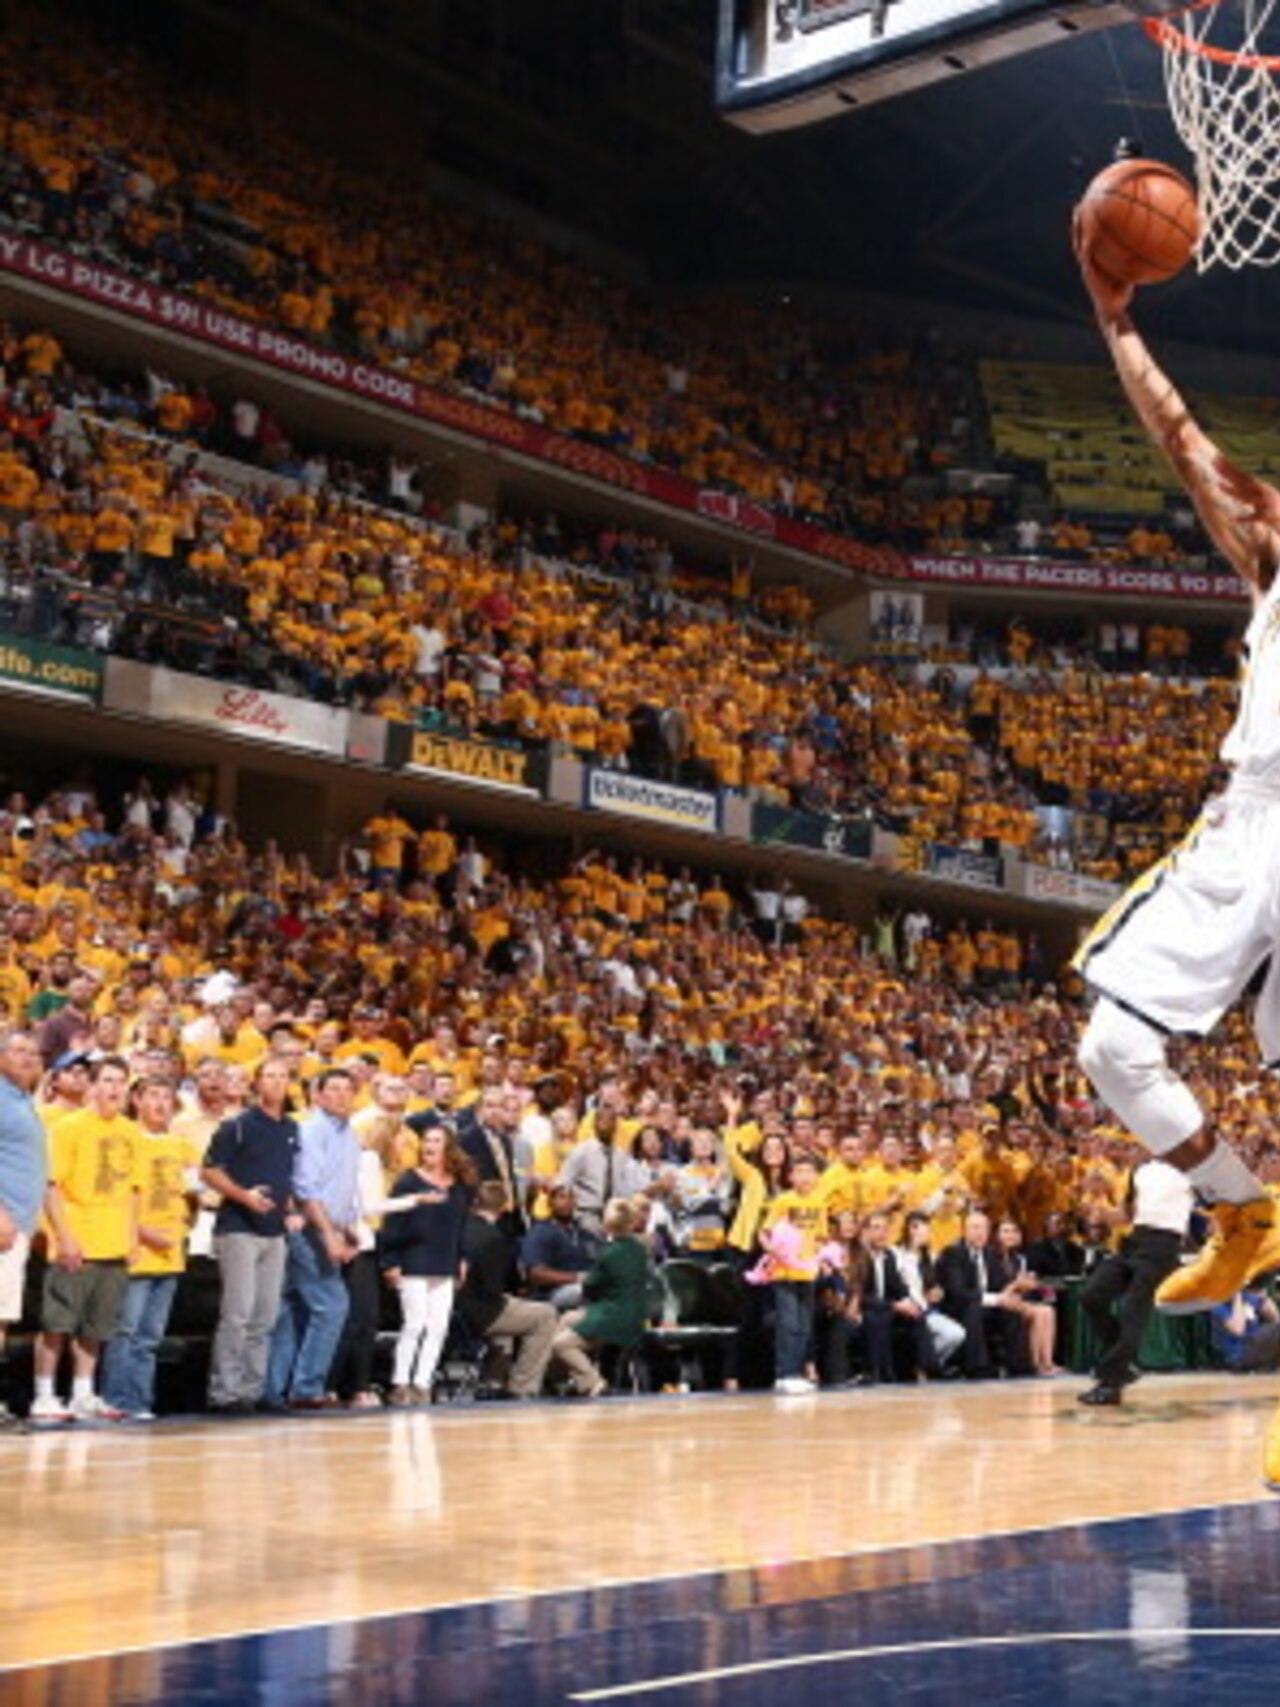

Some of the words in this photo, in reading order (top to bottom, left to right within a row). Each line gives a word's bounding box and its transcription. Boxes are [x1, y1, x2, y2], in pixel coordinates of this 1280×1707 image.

[28, 246, 67, 278] LG
[72, 264, 152, 311] PIZZA
[160, 295, 200, 328] $9!
[206, 311, 254, 347] USE
[257, 331, 347, 380] PROMO
[352, 365, 415, 406] CODE
[912, 558, 976, 580] WHEN
[981, 562, 1022, 583] THE
[1025, 565, 1103, 588] PACERS
[1106, 569, 1175, 592] SCORE
[215, 687, 288, 734] Lilly
